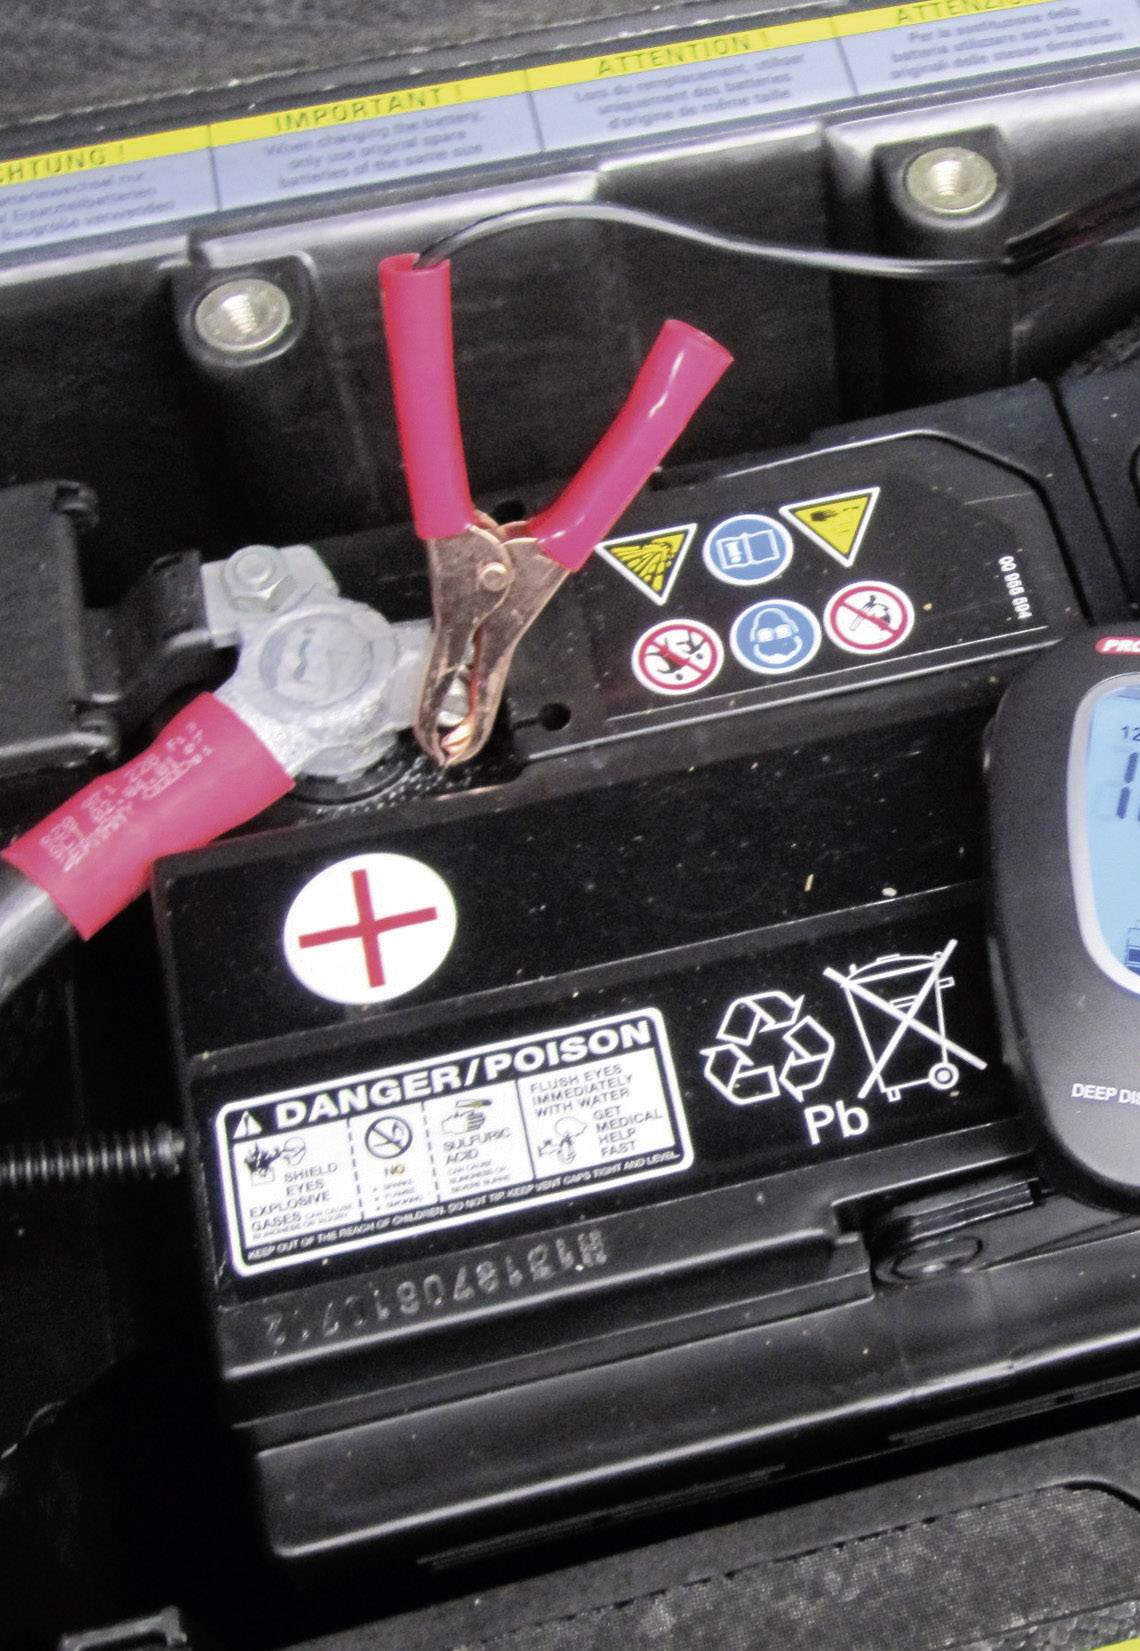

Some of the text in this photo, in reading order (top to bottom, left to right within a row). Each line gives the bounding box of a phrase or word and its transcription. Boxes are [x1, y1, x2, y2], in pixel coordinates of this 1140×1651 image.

[596, 34, 750, 75] ATTENTION
[272, 87, 442, 132] IMPORTANT
[275, 1018, 653, 1130] DANGER/POISON
[529, 1063, 623, 1093] FLUSH EYES
[531, 1074, 633, 1105] IMMEDIATELY
[1071, 1082, 1117, 1102] DEEP
[533, 1087, 631, 1117] WITH WATER
[592, 1105, 621, 1120] GET
[594, 1107, 663, 1131] MEDICAL
[803, 1099, 870, 1146] Pb
[597, 1127, 637, 1144] HELP
[443, 1146, 480, 1164] ACID
[599, 1140, 637, 1157] FAST
[283, 1162, 338, 1182] SHIELD
[383, 1163, 406, 1177] NO
[284, 1179, 325, 1196] EYES
[248, 1191, 331, 1218] EXPLOSIVE
[250, 1211, 302, 1231] GASES
[247, 1245, 276, 1260] KEEP
[276, 1240, 299, 1253] OUT
